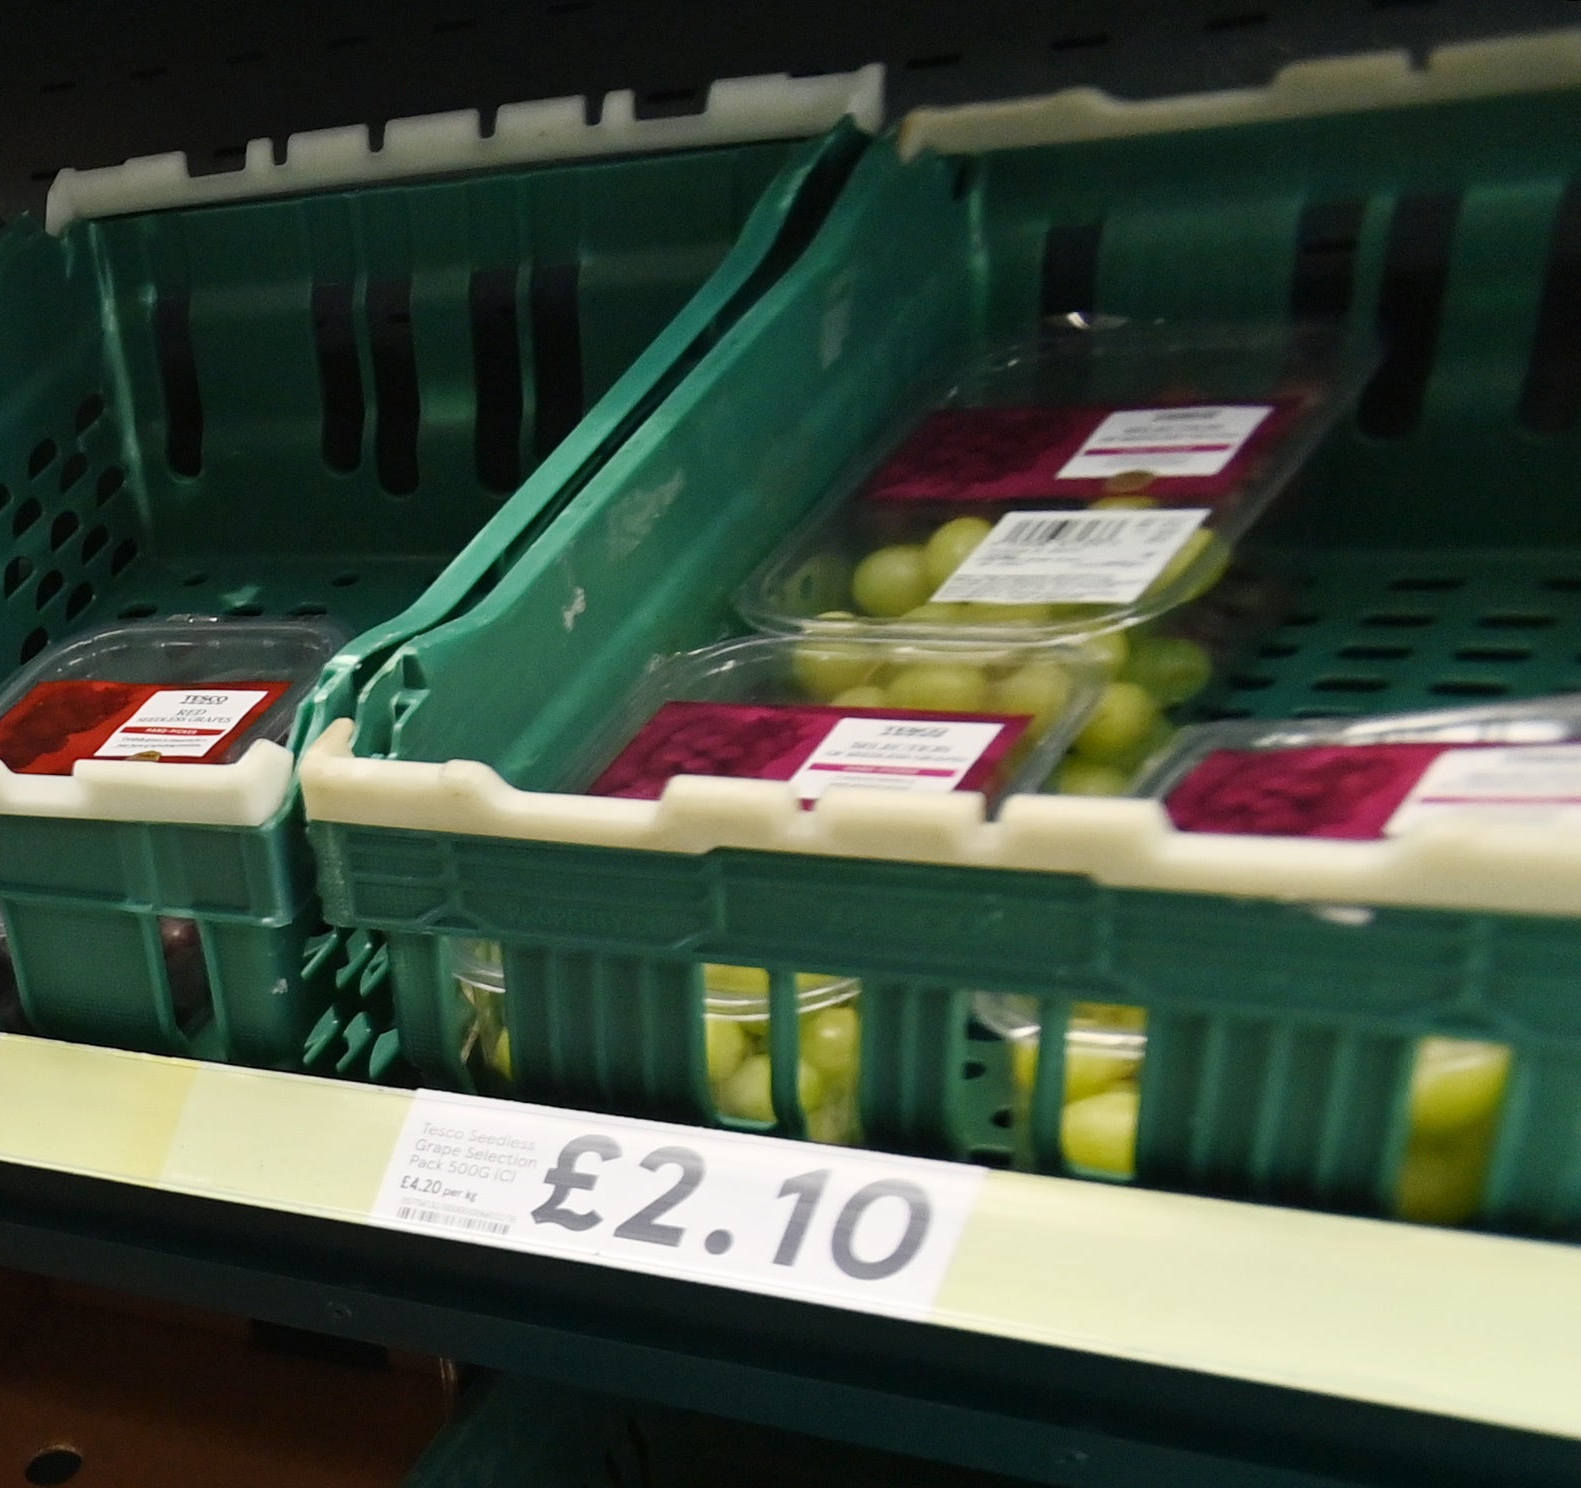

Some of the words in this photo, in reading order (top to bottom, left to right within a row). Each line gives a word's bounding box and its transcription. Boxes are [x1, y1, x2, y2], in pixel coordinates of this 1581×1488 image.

[423, 1122, 464, 1139] Tesco
[468, 1130, 535, 1151] Seedless
[415, 1139, 461, 1157] Grape
[466, 1146, 538, 1168] Selection
[409, 1155, 442, 1171] Pack
[448, 1161, 491, 1178] 500G
[494, 1170, 517, 1183] (C)
[400, 1175, 443, 1194] £4.20
[443, 1187, 462, 1198] per
[465, 1190, 477, 1203] kg
[530, 1134, 932, 1280] £2.10
